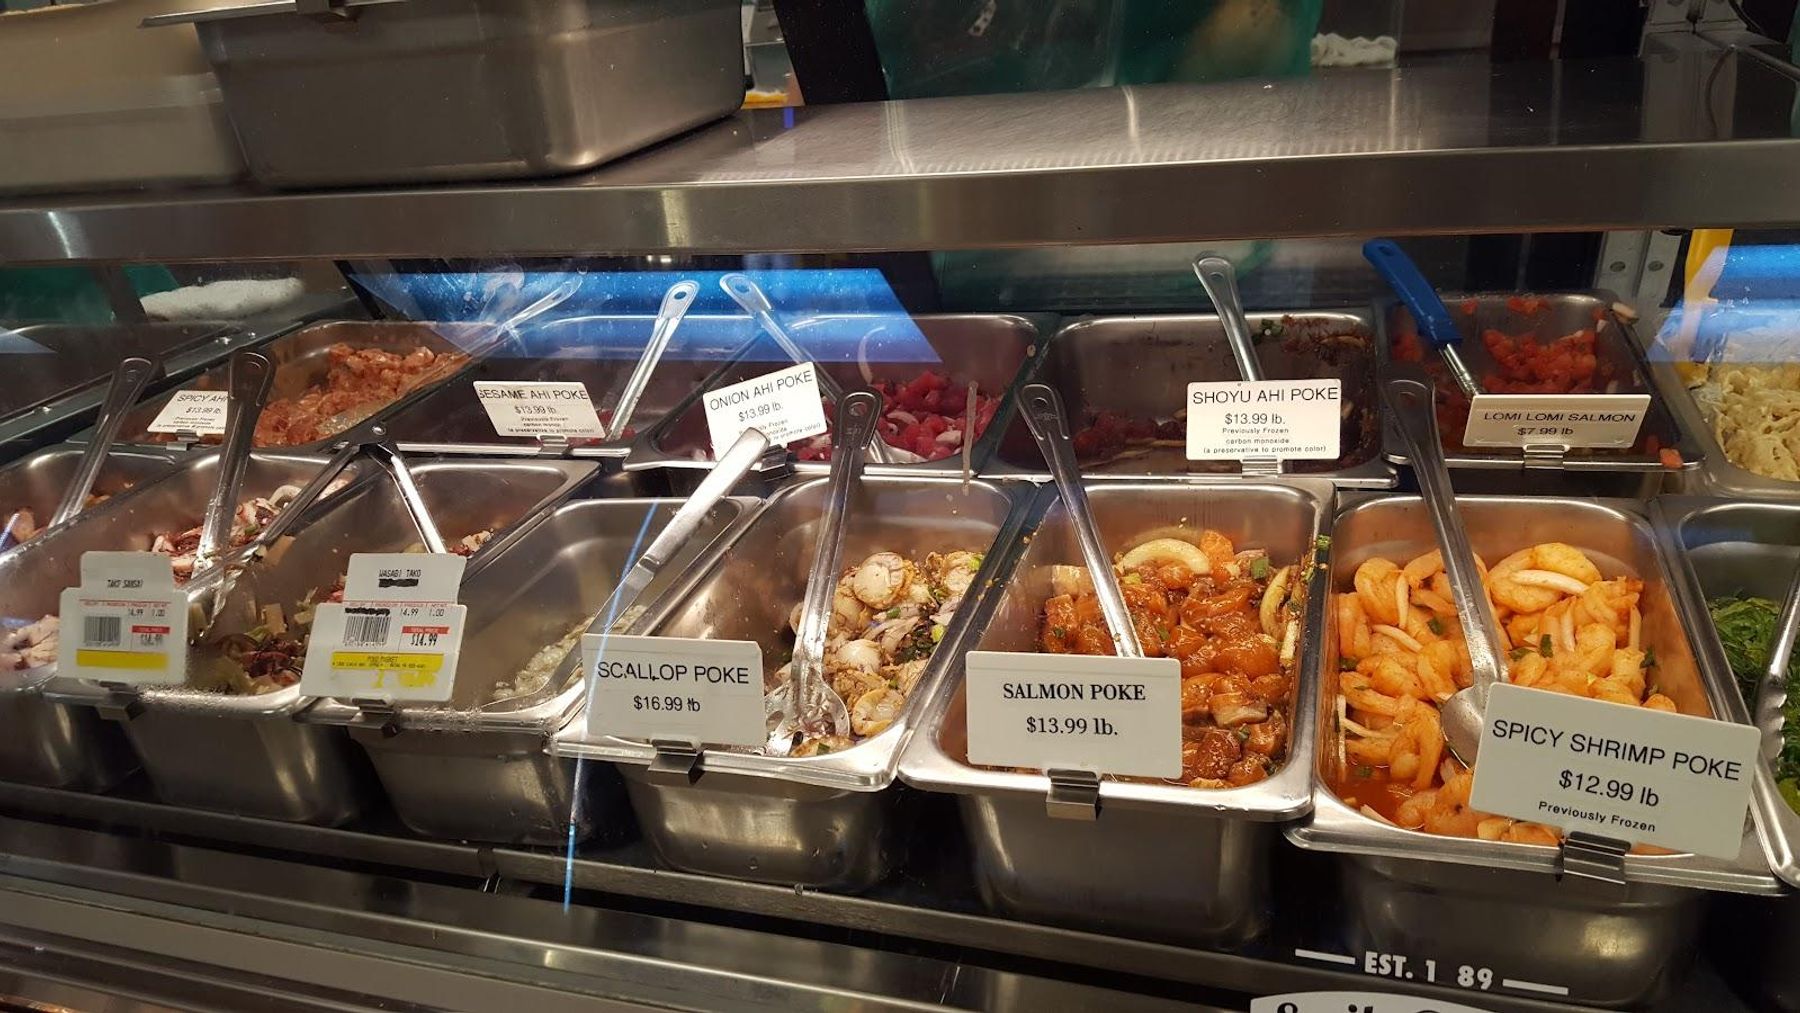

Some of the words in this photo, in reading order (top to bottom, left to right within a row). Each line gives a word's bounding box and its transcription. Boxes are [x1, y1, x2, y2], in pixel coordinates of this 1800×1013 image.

[177, 394, 210, 402] SPICY
[531, 390, 551, 400] AHI
[553, 390, 589, 400] POKE
[710, 390, 750, 411] ONION
[753, 382, 774, 398] AHI
[776, 370, 813, 390] POKE
[1193, 390, 1251, 404] SHOYU
[1257, 389, 1285, 402] AHI
[1291, 387, 1338, 401] POKE
[514, 405, 546, 414] $13.99
[739, 403, 770, 422] $13.99
[1484, 412, 1521, 421] LOMI
[1526, 413, 1564, 421] LOMI
[1567, 413, 1636, 422] SALMON
[1224, 412, 1268, 425] $13.99
[1271, 413, 1286, 425] lb.
[1222, 427, 1260, 435] Previously
[1517, 427, 1557, 436] $7.99
[1561, 427, 1574, 435] lb
[1213, 446, 1259, 454] preservative
[1304, 445, 1327, 453] color)
[378, 569, 402, 578] WASABI
[406, 569, 422, 577] TAKO
[410, 634, 438, 647] $14.99
[597, 661, 688, 682] SCALLOP
[694, 665, 750, 684] POKE
[1003, 683, 1084, 700] SALMON
[1091, 684, 1146, 701] POKE
[633, 695, 683, 712] $16.99
[1026, 716, 1088, 734] $13.99
[1094, 717, 1118, 736] lb.
[1492, 719, 1565, 748] SPICY
[1570, 733, 1666, 766] SHRIMP
[1672, 751, 1742, 781] POKE
[1558, 769, 1634, 801] $12.99
[1640, 786, 1660, 807] lb
[1538, 800, 1607, 824] Previously
[1611, 814, 1656, 832] Frozen
[1364, 950, 1414, 979] EST.
